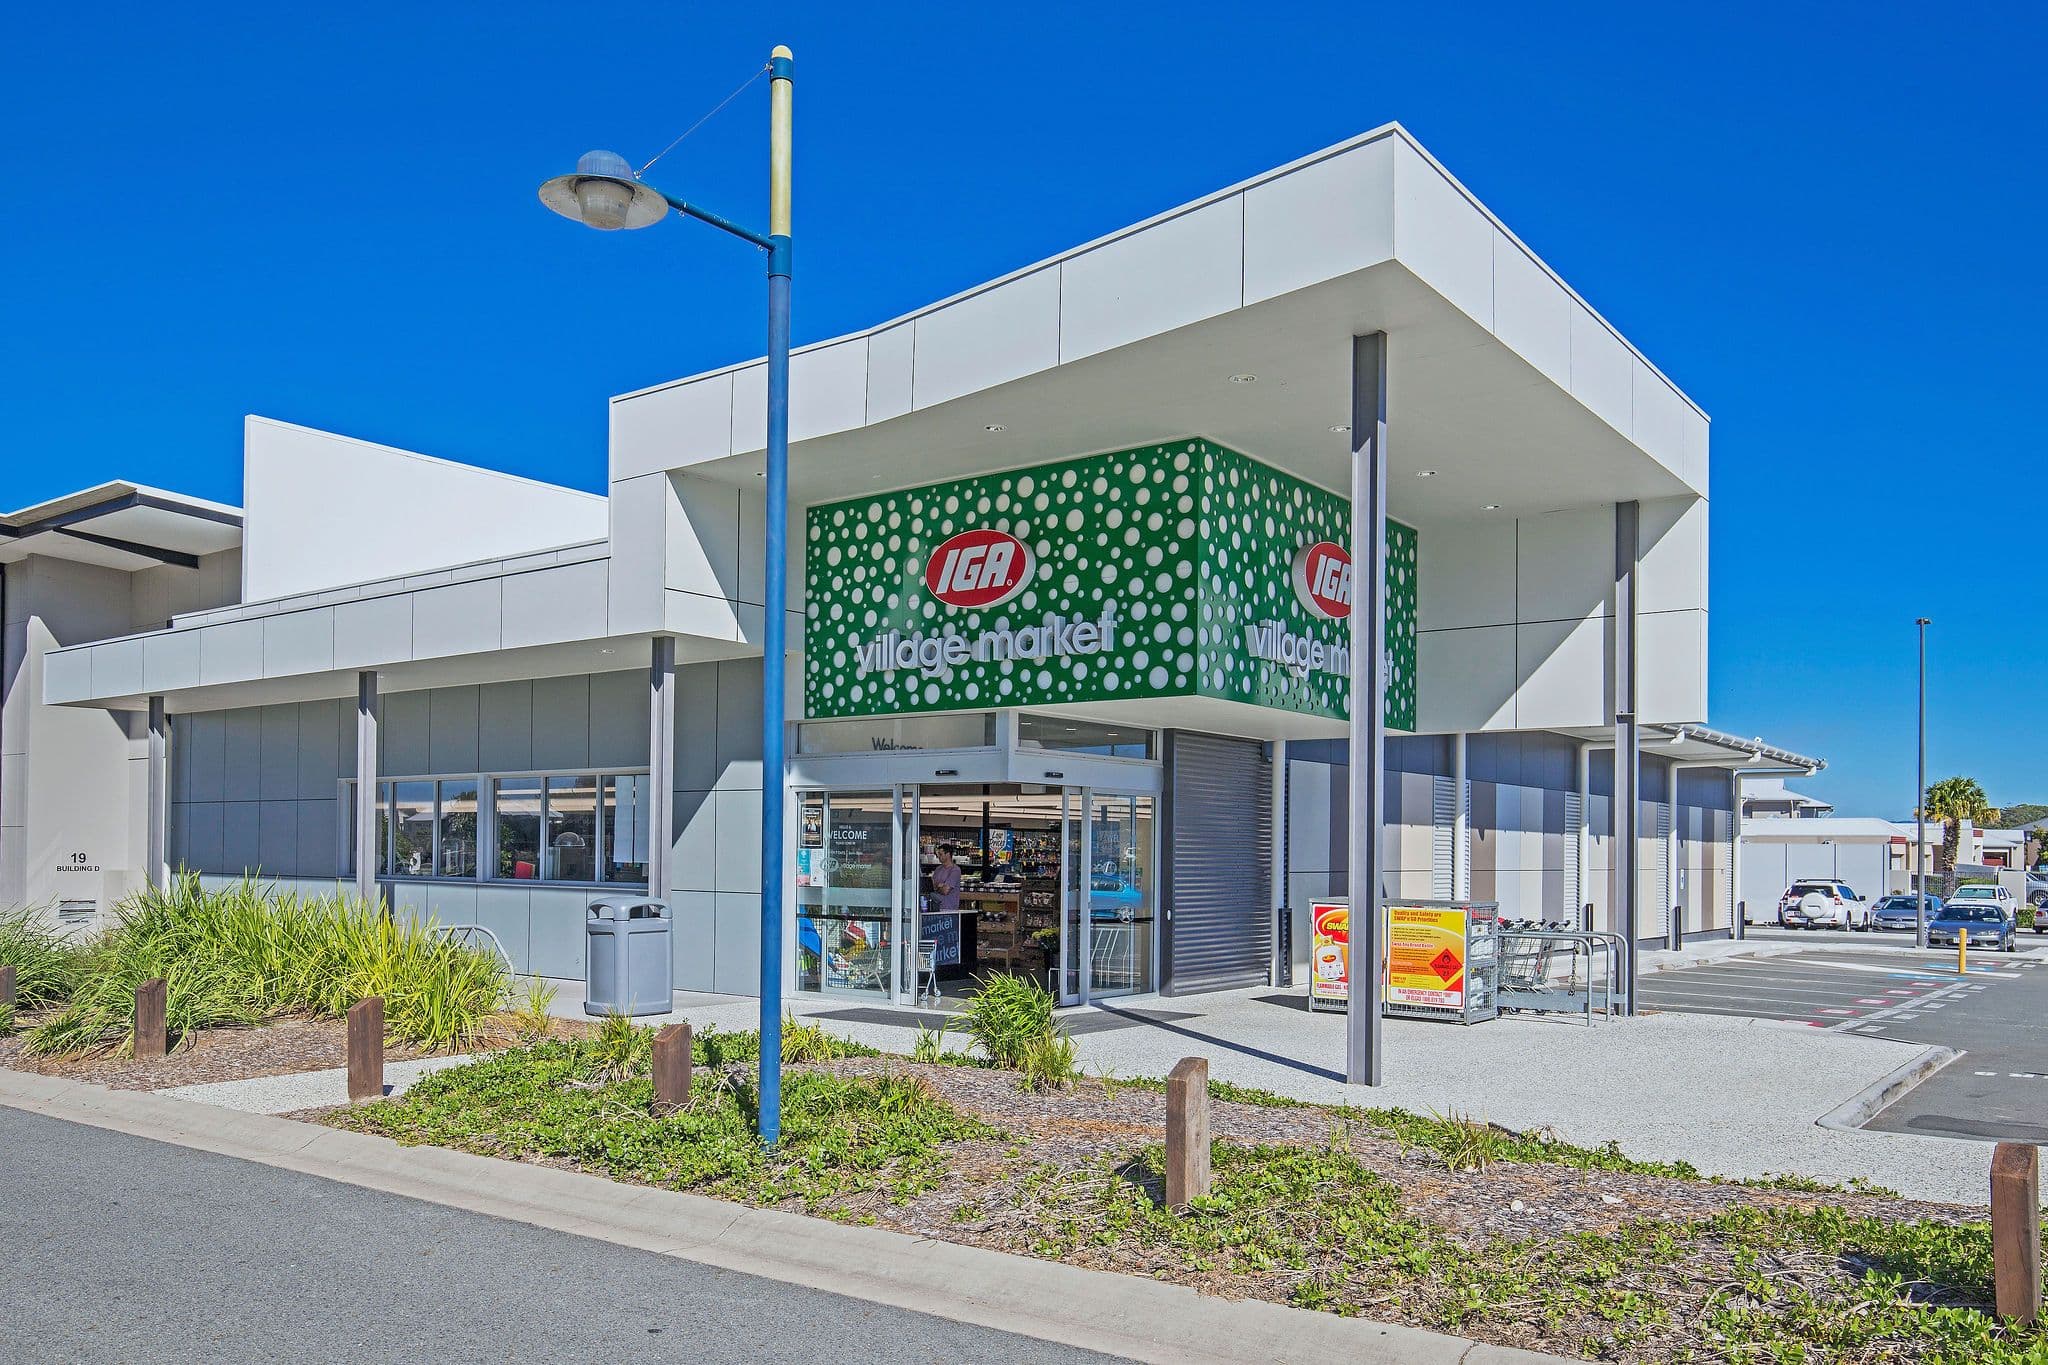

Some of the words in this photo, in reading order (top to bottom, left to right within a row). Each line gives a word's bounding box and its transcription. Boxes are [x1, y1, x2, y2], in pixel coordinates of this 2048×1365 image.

[935, 540, 1015, 595] IGA
[855, 632, 972, 678] village
[978, 610, 1118, 663] market
[1244, 618, 1325, 682] village
[70, 852, 86, 863] 19
